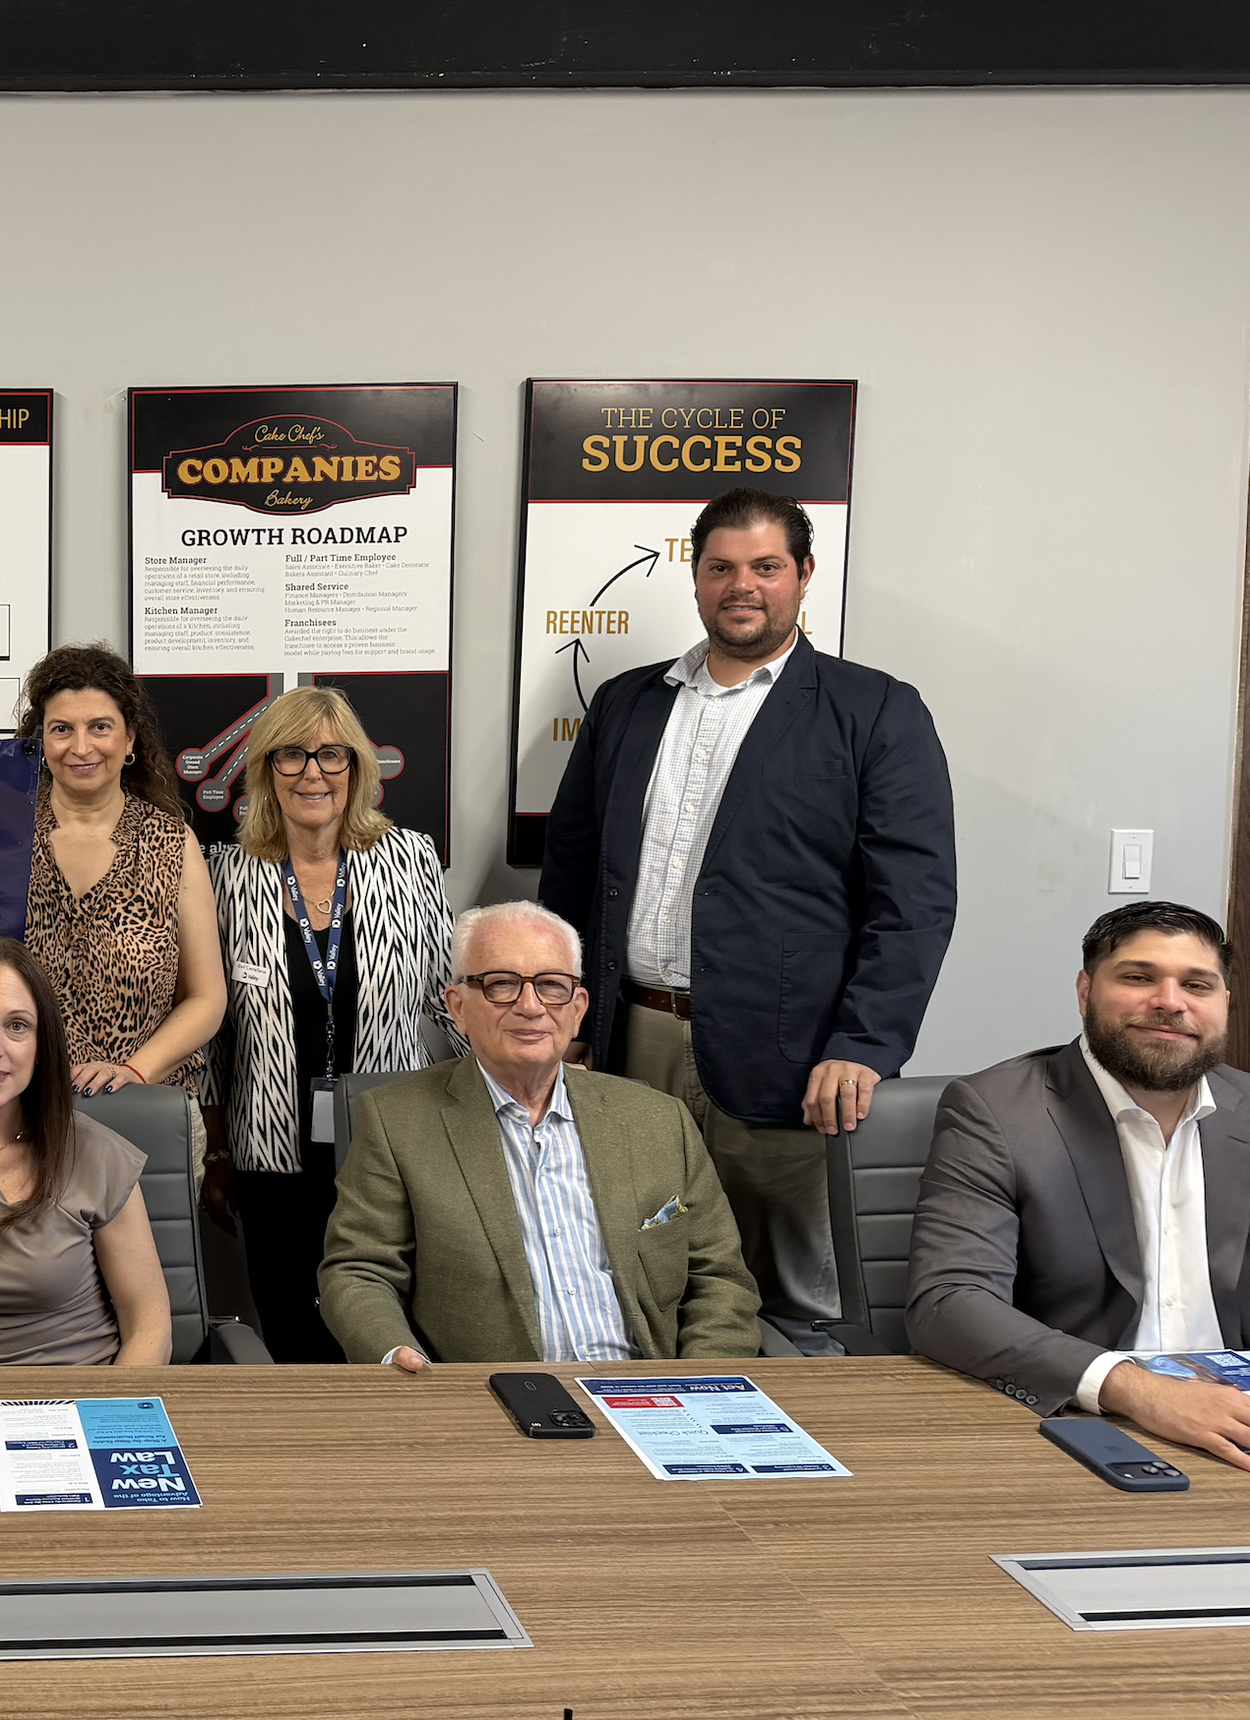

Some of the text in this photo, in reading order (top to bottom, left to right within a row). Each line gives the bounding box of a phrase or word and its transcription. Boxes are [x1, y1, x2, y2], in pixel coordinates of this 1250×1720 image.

[601, 408, 786, 429] THE CYCLE OF
[254, 424, 324, 444] Cake Chef's
[582, 434, 802, 472] SUCCESS
[177, 455, 400, 484] COMPANIES
[264, 489, 313, 510] Bakery
[181, 526, 407, 546] GROWTH ROADMAP
[144, 556, 206, 565] Store Manager
[285, 554, 302, 562] Full
[329, 553, 352, 561] Time
[354, 553, 396, 562] Employee
[285, 582, 348, 591] Shared Service
[144, 606, 217, 615] Kitchen Manager
[284, 618, 336, 626] Franchisees
[546, 610, 629, 634] REENTER
[110, 1451, 176, 1464] Law
[119, 1464, 180, 1477] Tax
[112, 1477, 186, 1492] New
